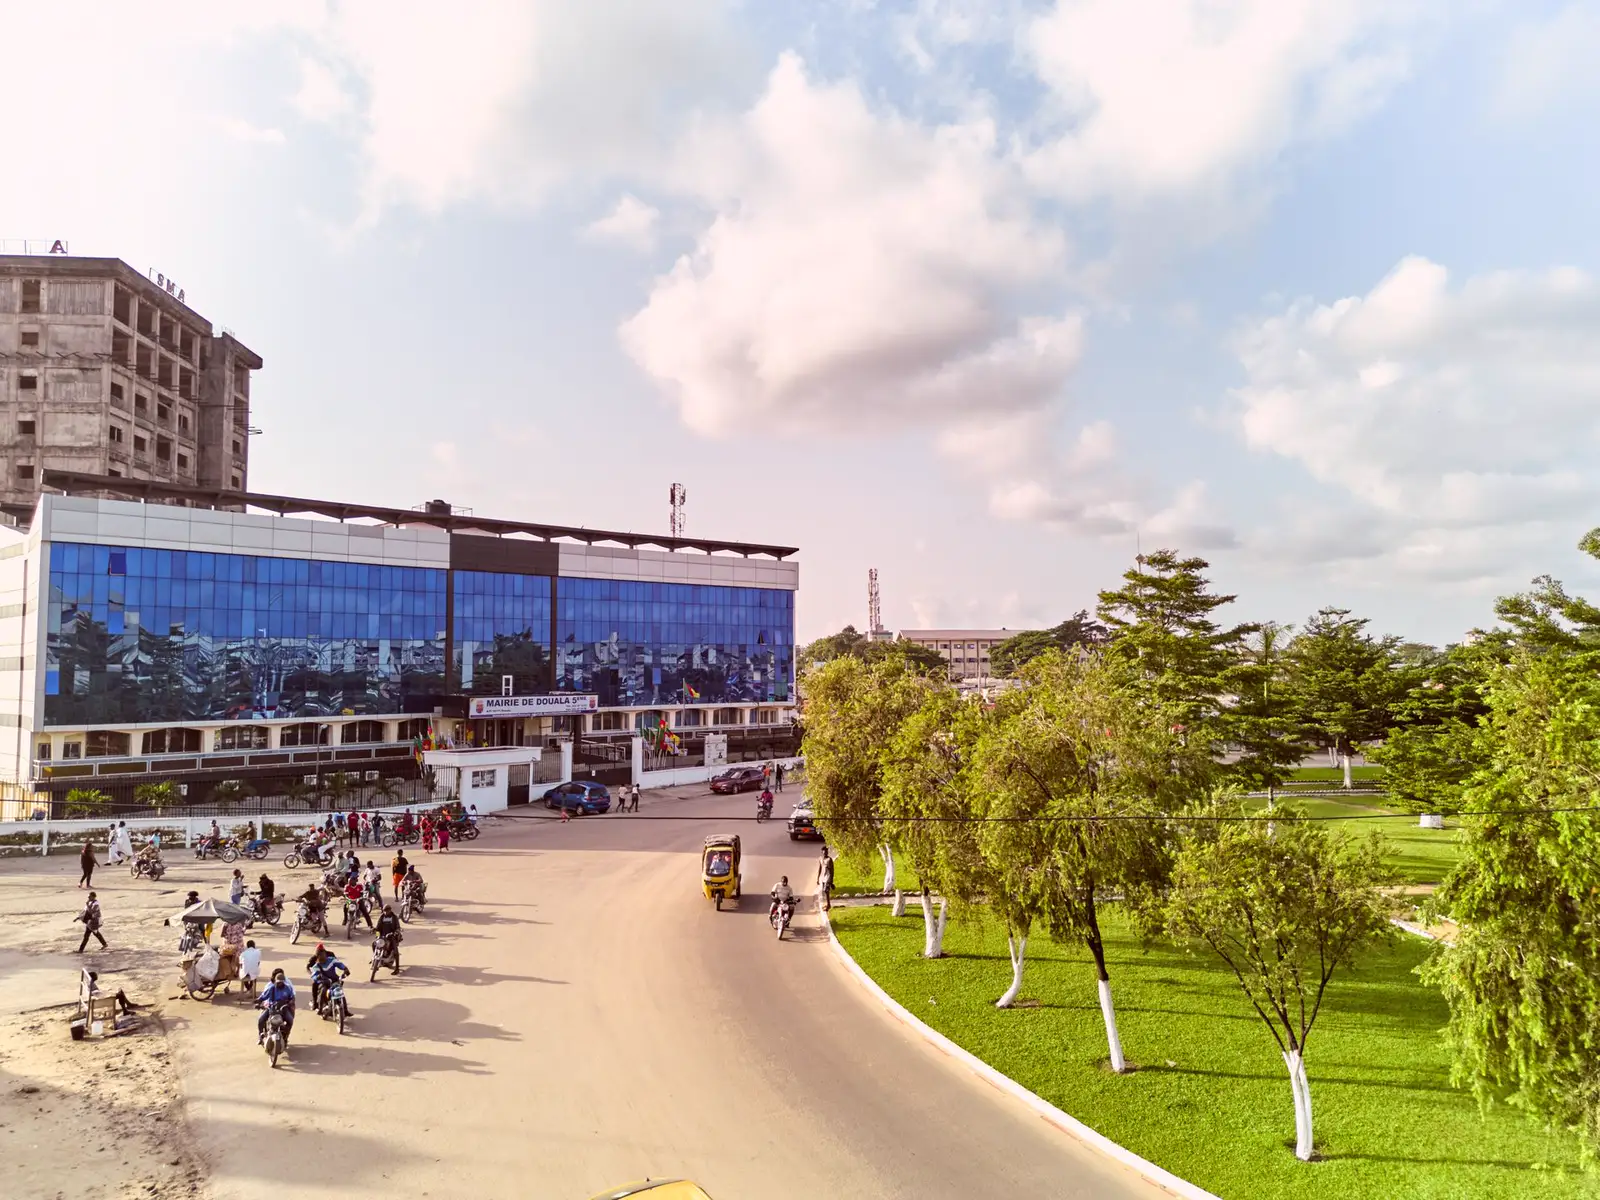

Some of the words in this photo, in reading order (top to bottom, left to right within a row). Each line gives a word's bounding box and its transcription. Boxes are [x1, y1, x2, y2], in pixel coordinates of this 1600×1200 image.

[48, 239, 67, 254] A
[486, 698, 519, 707] MAIRIE
[521, 698, 534, 706] DE
[536, 697, 570, 705] DOUALA
